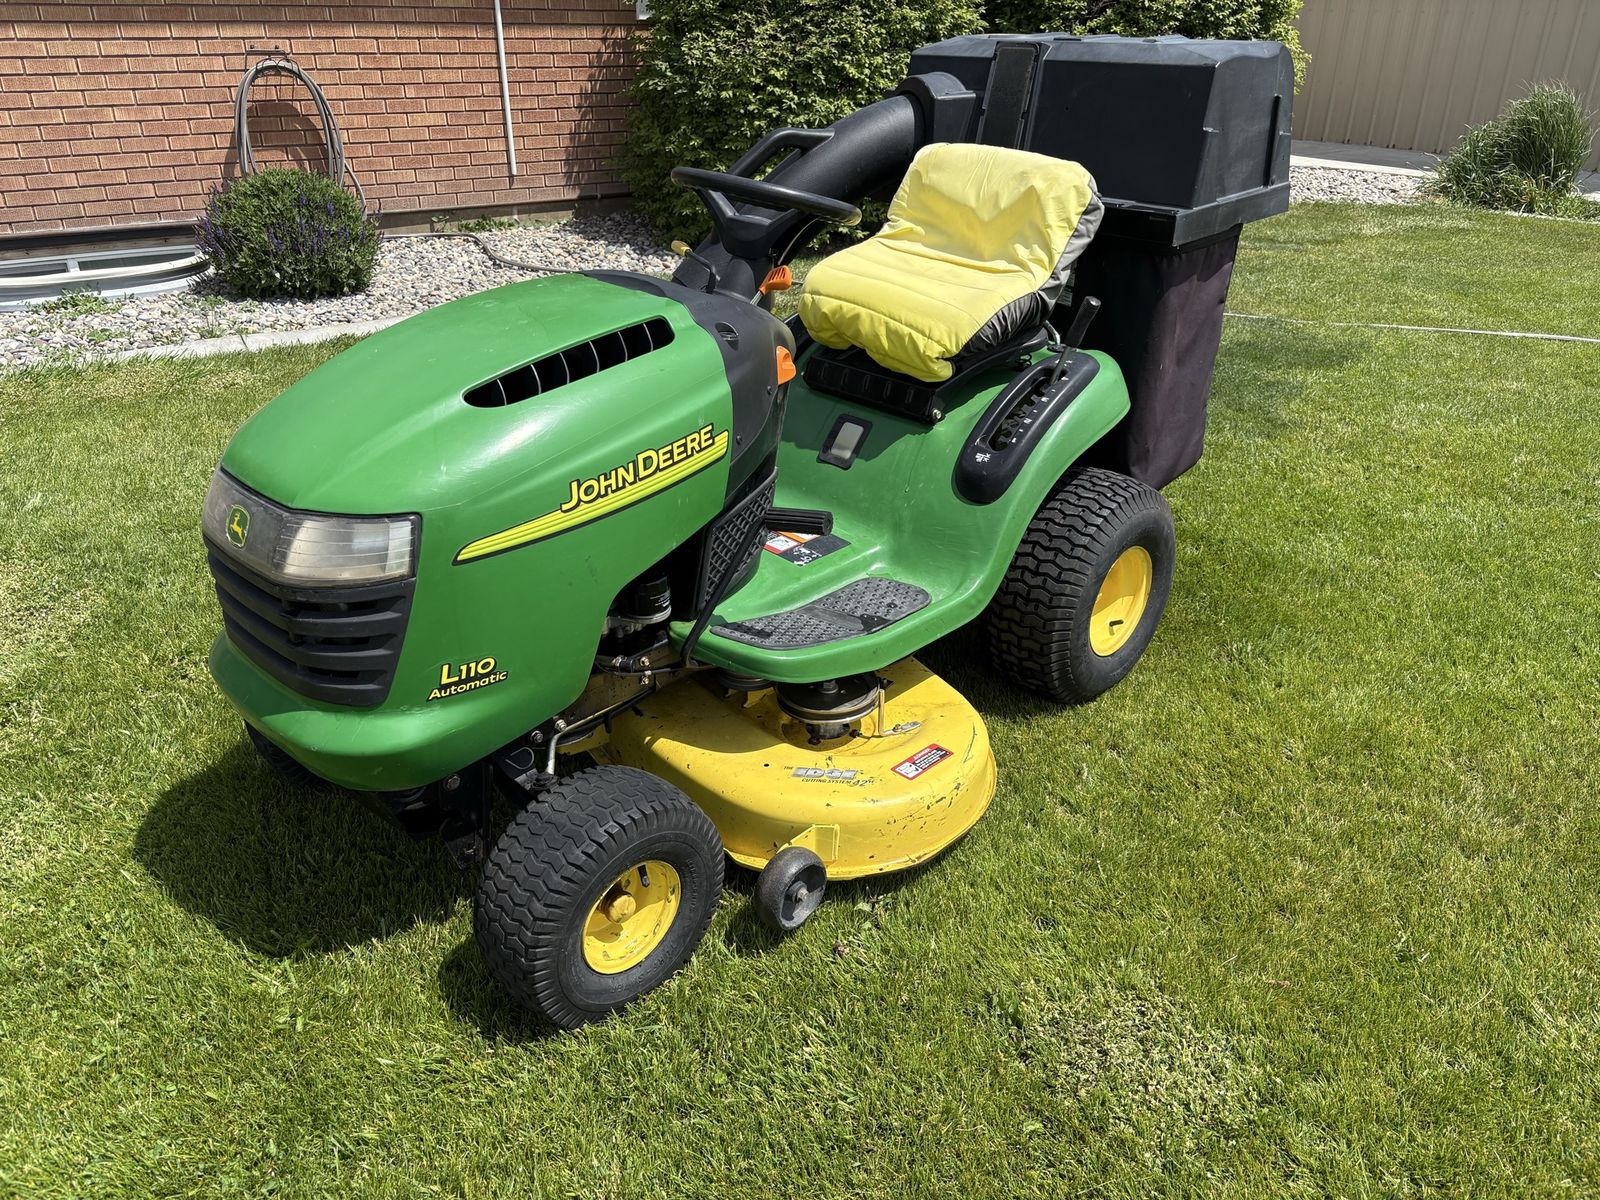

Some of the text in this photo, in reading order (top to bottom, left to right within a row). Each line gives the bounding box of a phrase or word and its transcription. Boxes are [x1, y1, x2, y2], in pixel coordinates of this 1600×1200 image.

[560, 423, 714, 512] JOHN DEERE
[440, 656, 497, 685] L110
[427, 671, 508, 700] Automatic
